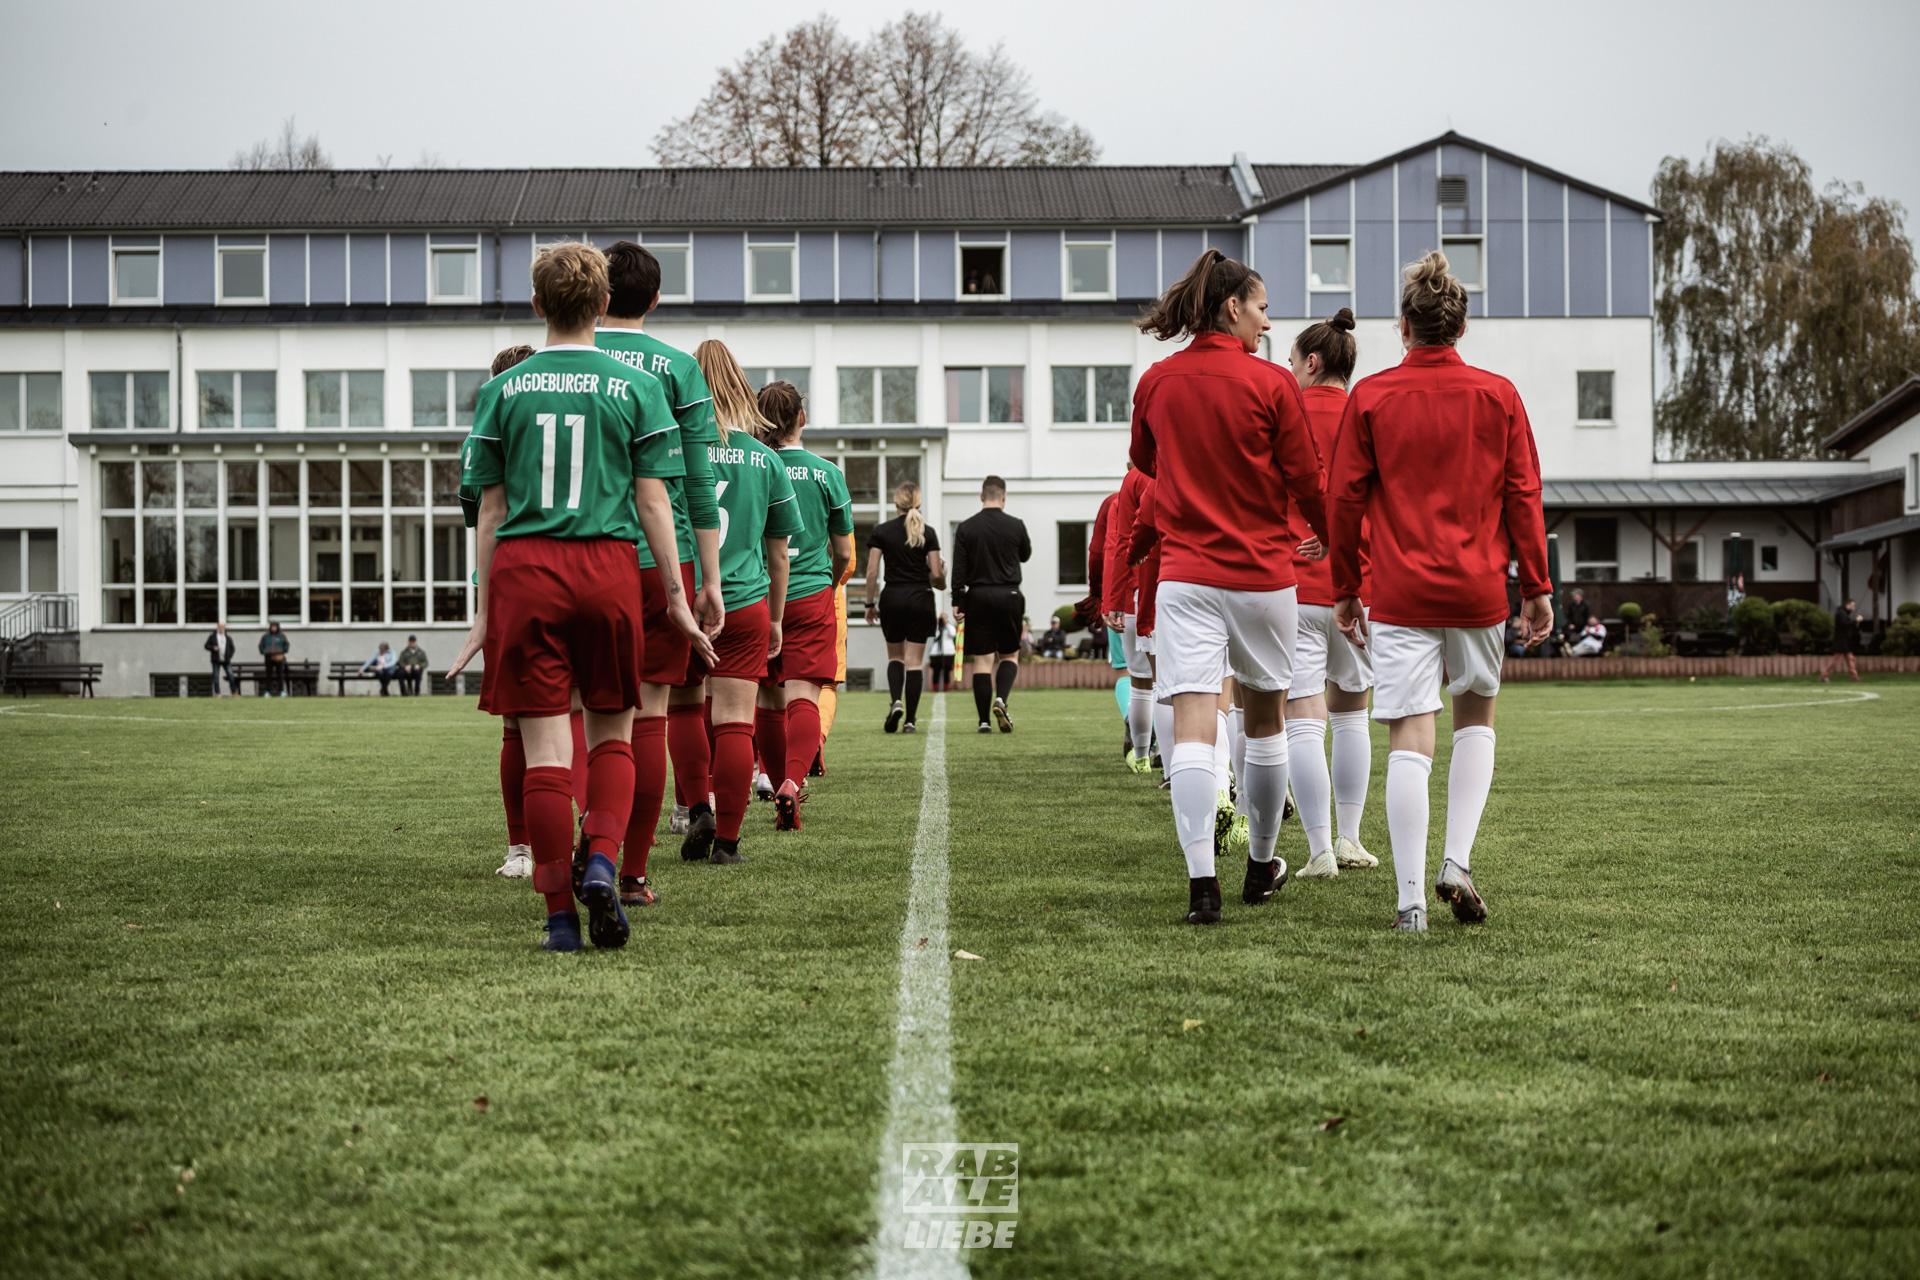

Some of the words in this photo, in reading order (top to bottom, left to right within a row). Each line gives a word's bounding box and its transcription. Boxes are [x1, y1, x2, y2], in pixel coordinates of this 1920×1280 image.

[651, 354, 672, 375] FFC
[502, 373, 600, 399] MAGDEBURGER
[606, 377, 631, 401] FFC
[536, 413, 585, 509] 11
[750, 450, 767, 469] FFC
[813, 468, 828, 484] FFC
